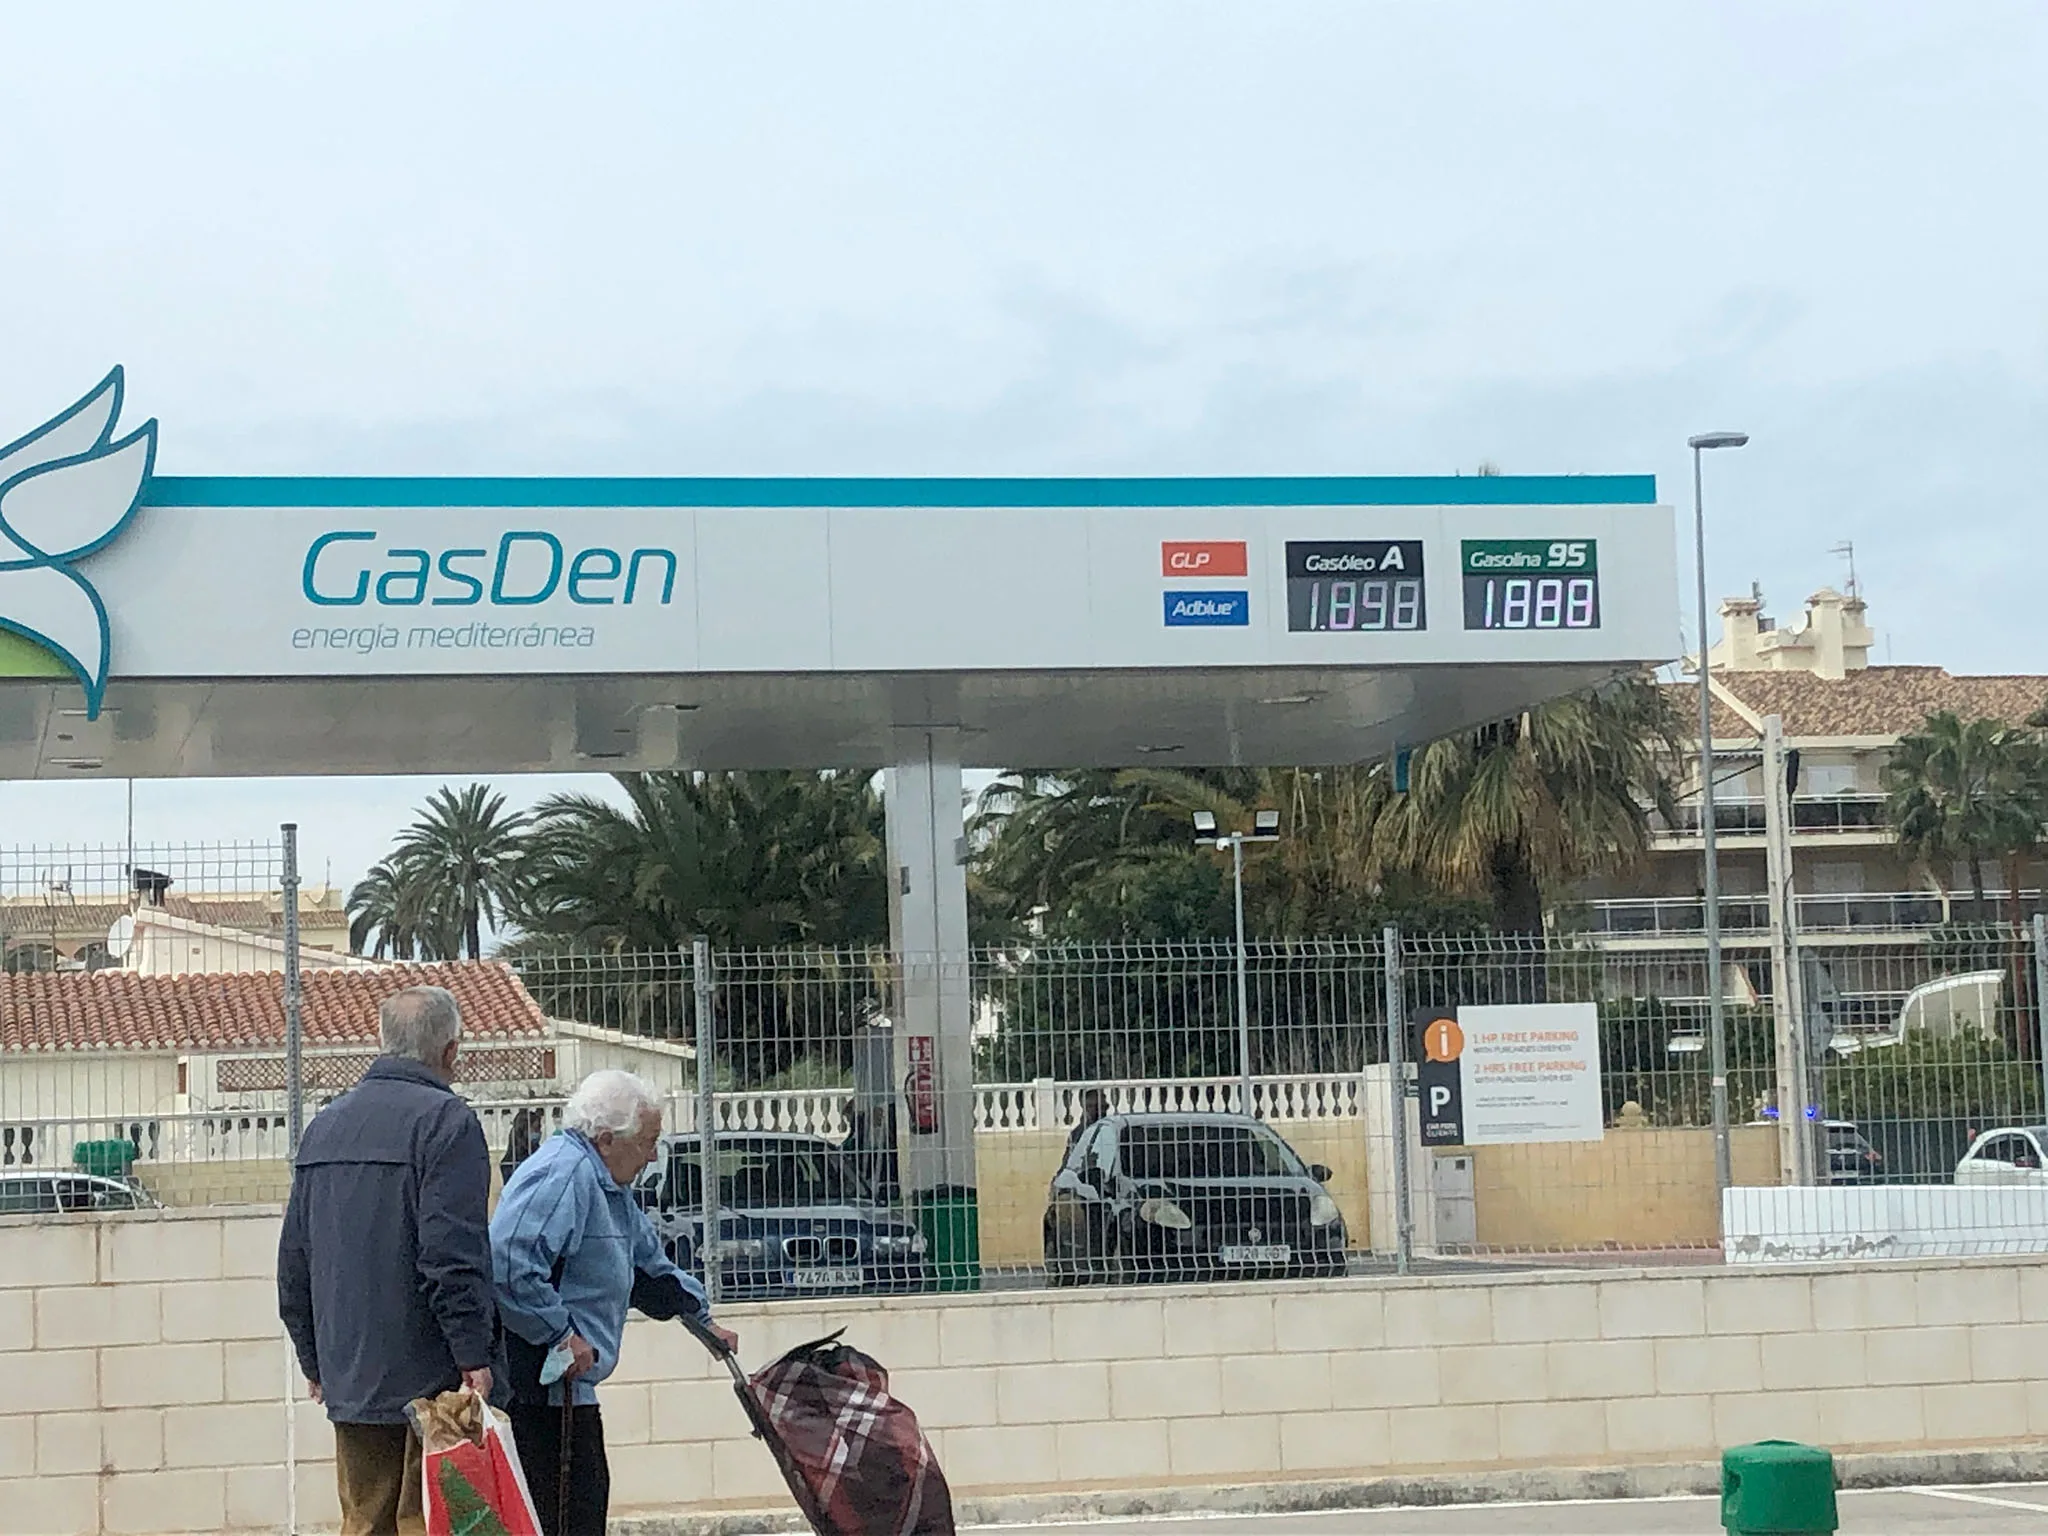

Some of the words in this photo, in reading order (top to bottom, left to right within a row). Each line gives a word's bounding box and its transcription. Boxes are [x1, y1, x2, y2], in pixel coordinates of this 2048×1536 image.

[302, 531, 677, 605] GasDen
[1170, 552, 1210, 568] GLP
[1306, 554, 1376, 571] Gasóleo
[1380, 545, 1405, 571] A
[1470, 551, 1541, 568] Gasolina
[1547, 543, 1587, 567] 95
[1310, 581, 1420, 630] 1.898
[1485, 579, 1593, 627] 1.888
[291, 622, 399, 654] energía
[407, 622, 594, 649] mediterránea
[1530, 1030, 1579, 1042] PARKING
